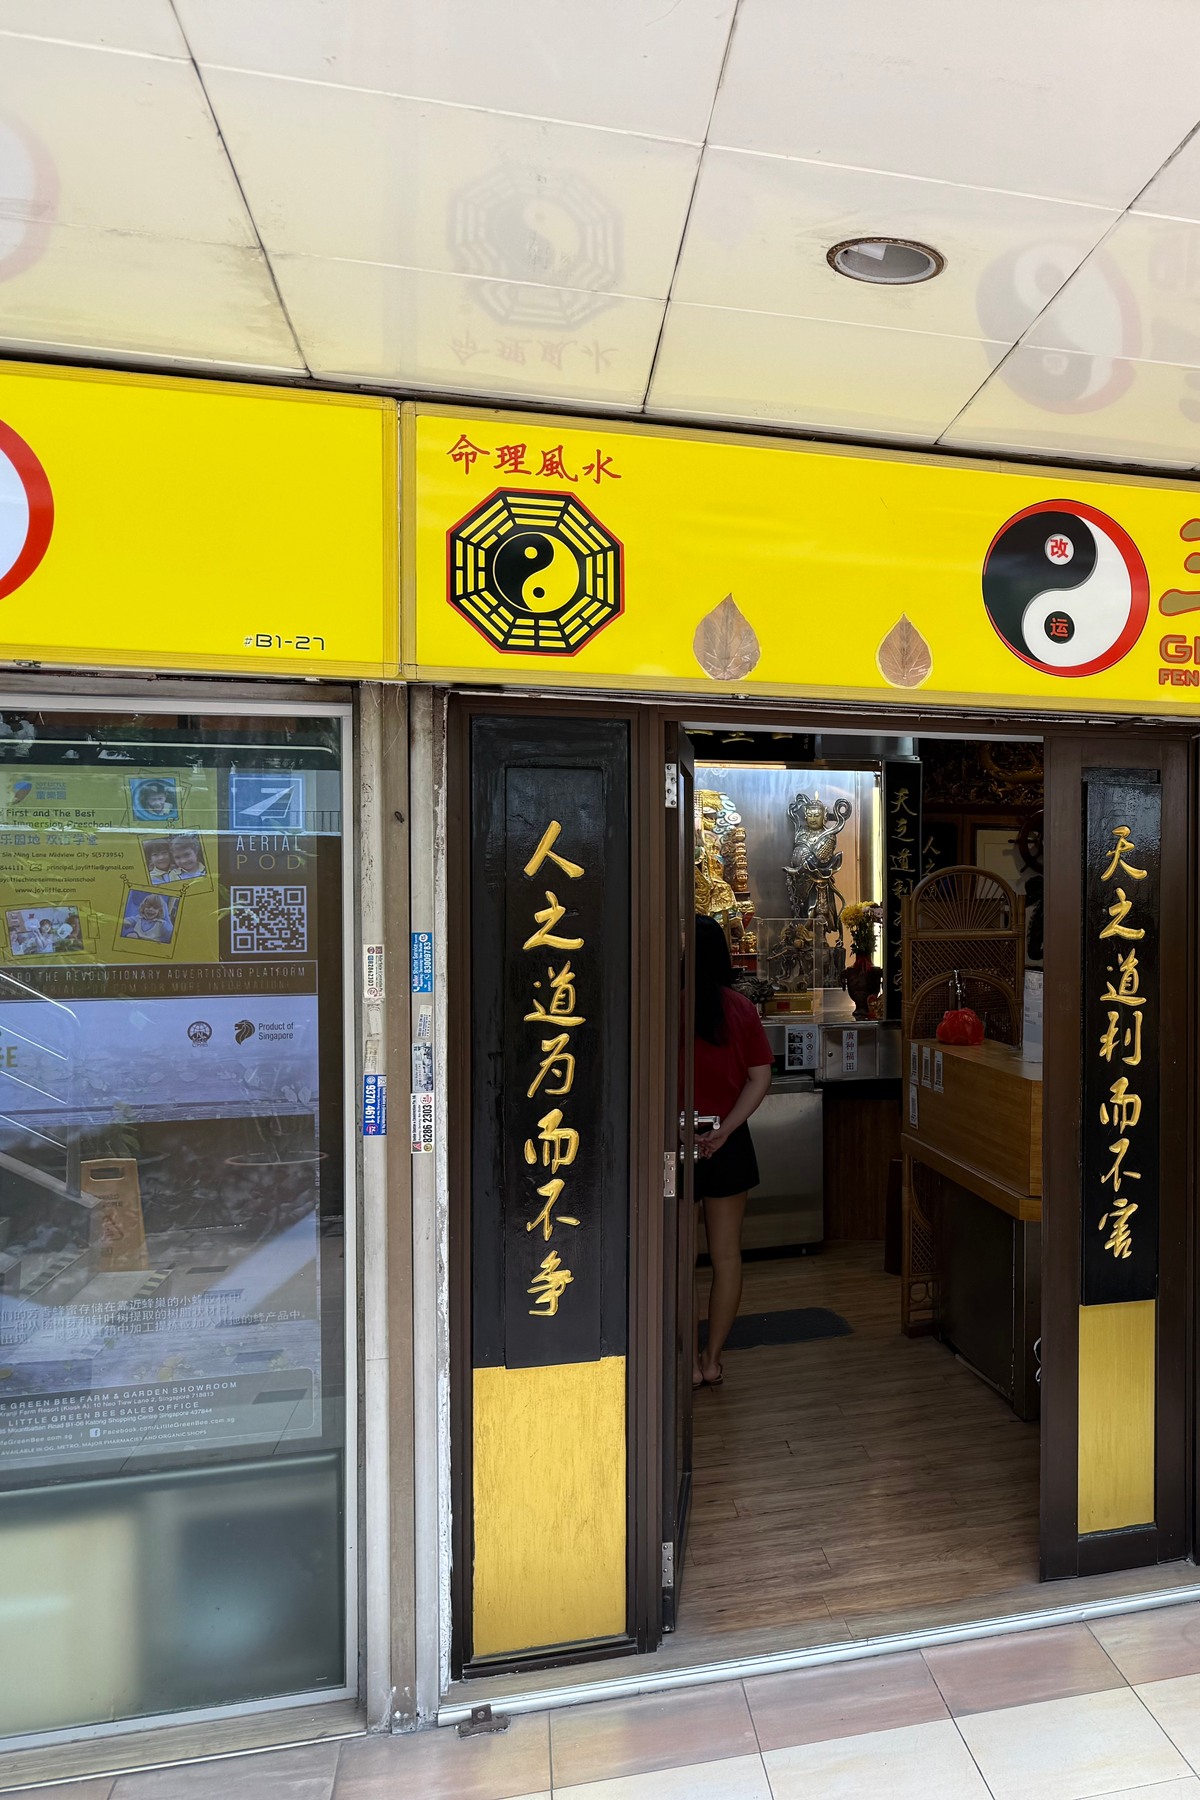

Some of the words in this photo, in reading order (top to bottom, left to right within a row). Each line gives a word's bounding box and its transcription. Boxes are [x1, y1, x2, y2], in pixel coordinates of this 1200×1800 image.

[446, 434, 622, 484] 命理風水
[1050, 538, 1069, 558] 改
[1050, 617, 1069, 638] 运
[243, 633, 327, 651] #B1-27
[7, 809, 28, 817] First
[33, 809, 49, 817] and
[54, 809, 71, 817] The
[75, 809, 95, 818] Best
[13, 820, 63, 830] Immersion
[67, 820, 112, 829] Preschool
[236, 835, 302, 851] AERIAL
[77, 851, 89, 859] City
[236, 854, 301, 870] POD
[39, 972, 59, 982] THE
[66, 970, 161, 982] REVOLUTIONARY
[167, 968, 243, 980] ADVERTISING
[249, 966, 306, 979] PLATFORM
[259, 1022, 284, 1031] Product
[286, 1022, 294, 1031] of
[259, 1032, 294, 1042] Singapore
[365, 1085, 376, 1103] 9370
[365, 1105, 376, 1123] 4611
[422, 1104, 433, 1123] 2303
[422, 1124, 433, 1143] 8286
[10, 1399, 50, 1410] GREEN
[54, 1396, 76, 1406] BEE
[80, 1394, 110, 1403] FARM
[123, 1388, 169, 1399] GARDEN
[172, 1381, 237, 1393] SHOWROOM
[8, 1416, 48, 1427] LITTLE
[51, 1413, 90, 1422] GREEN
[94, 1409, 116, 1418] BEE
[119, 1405, 155, 1416] SALES
[158, 1401, 200, 1412] OFFICE
[38, 1406, 60, 1414] Resort
